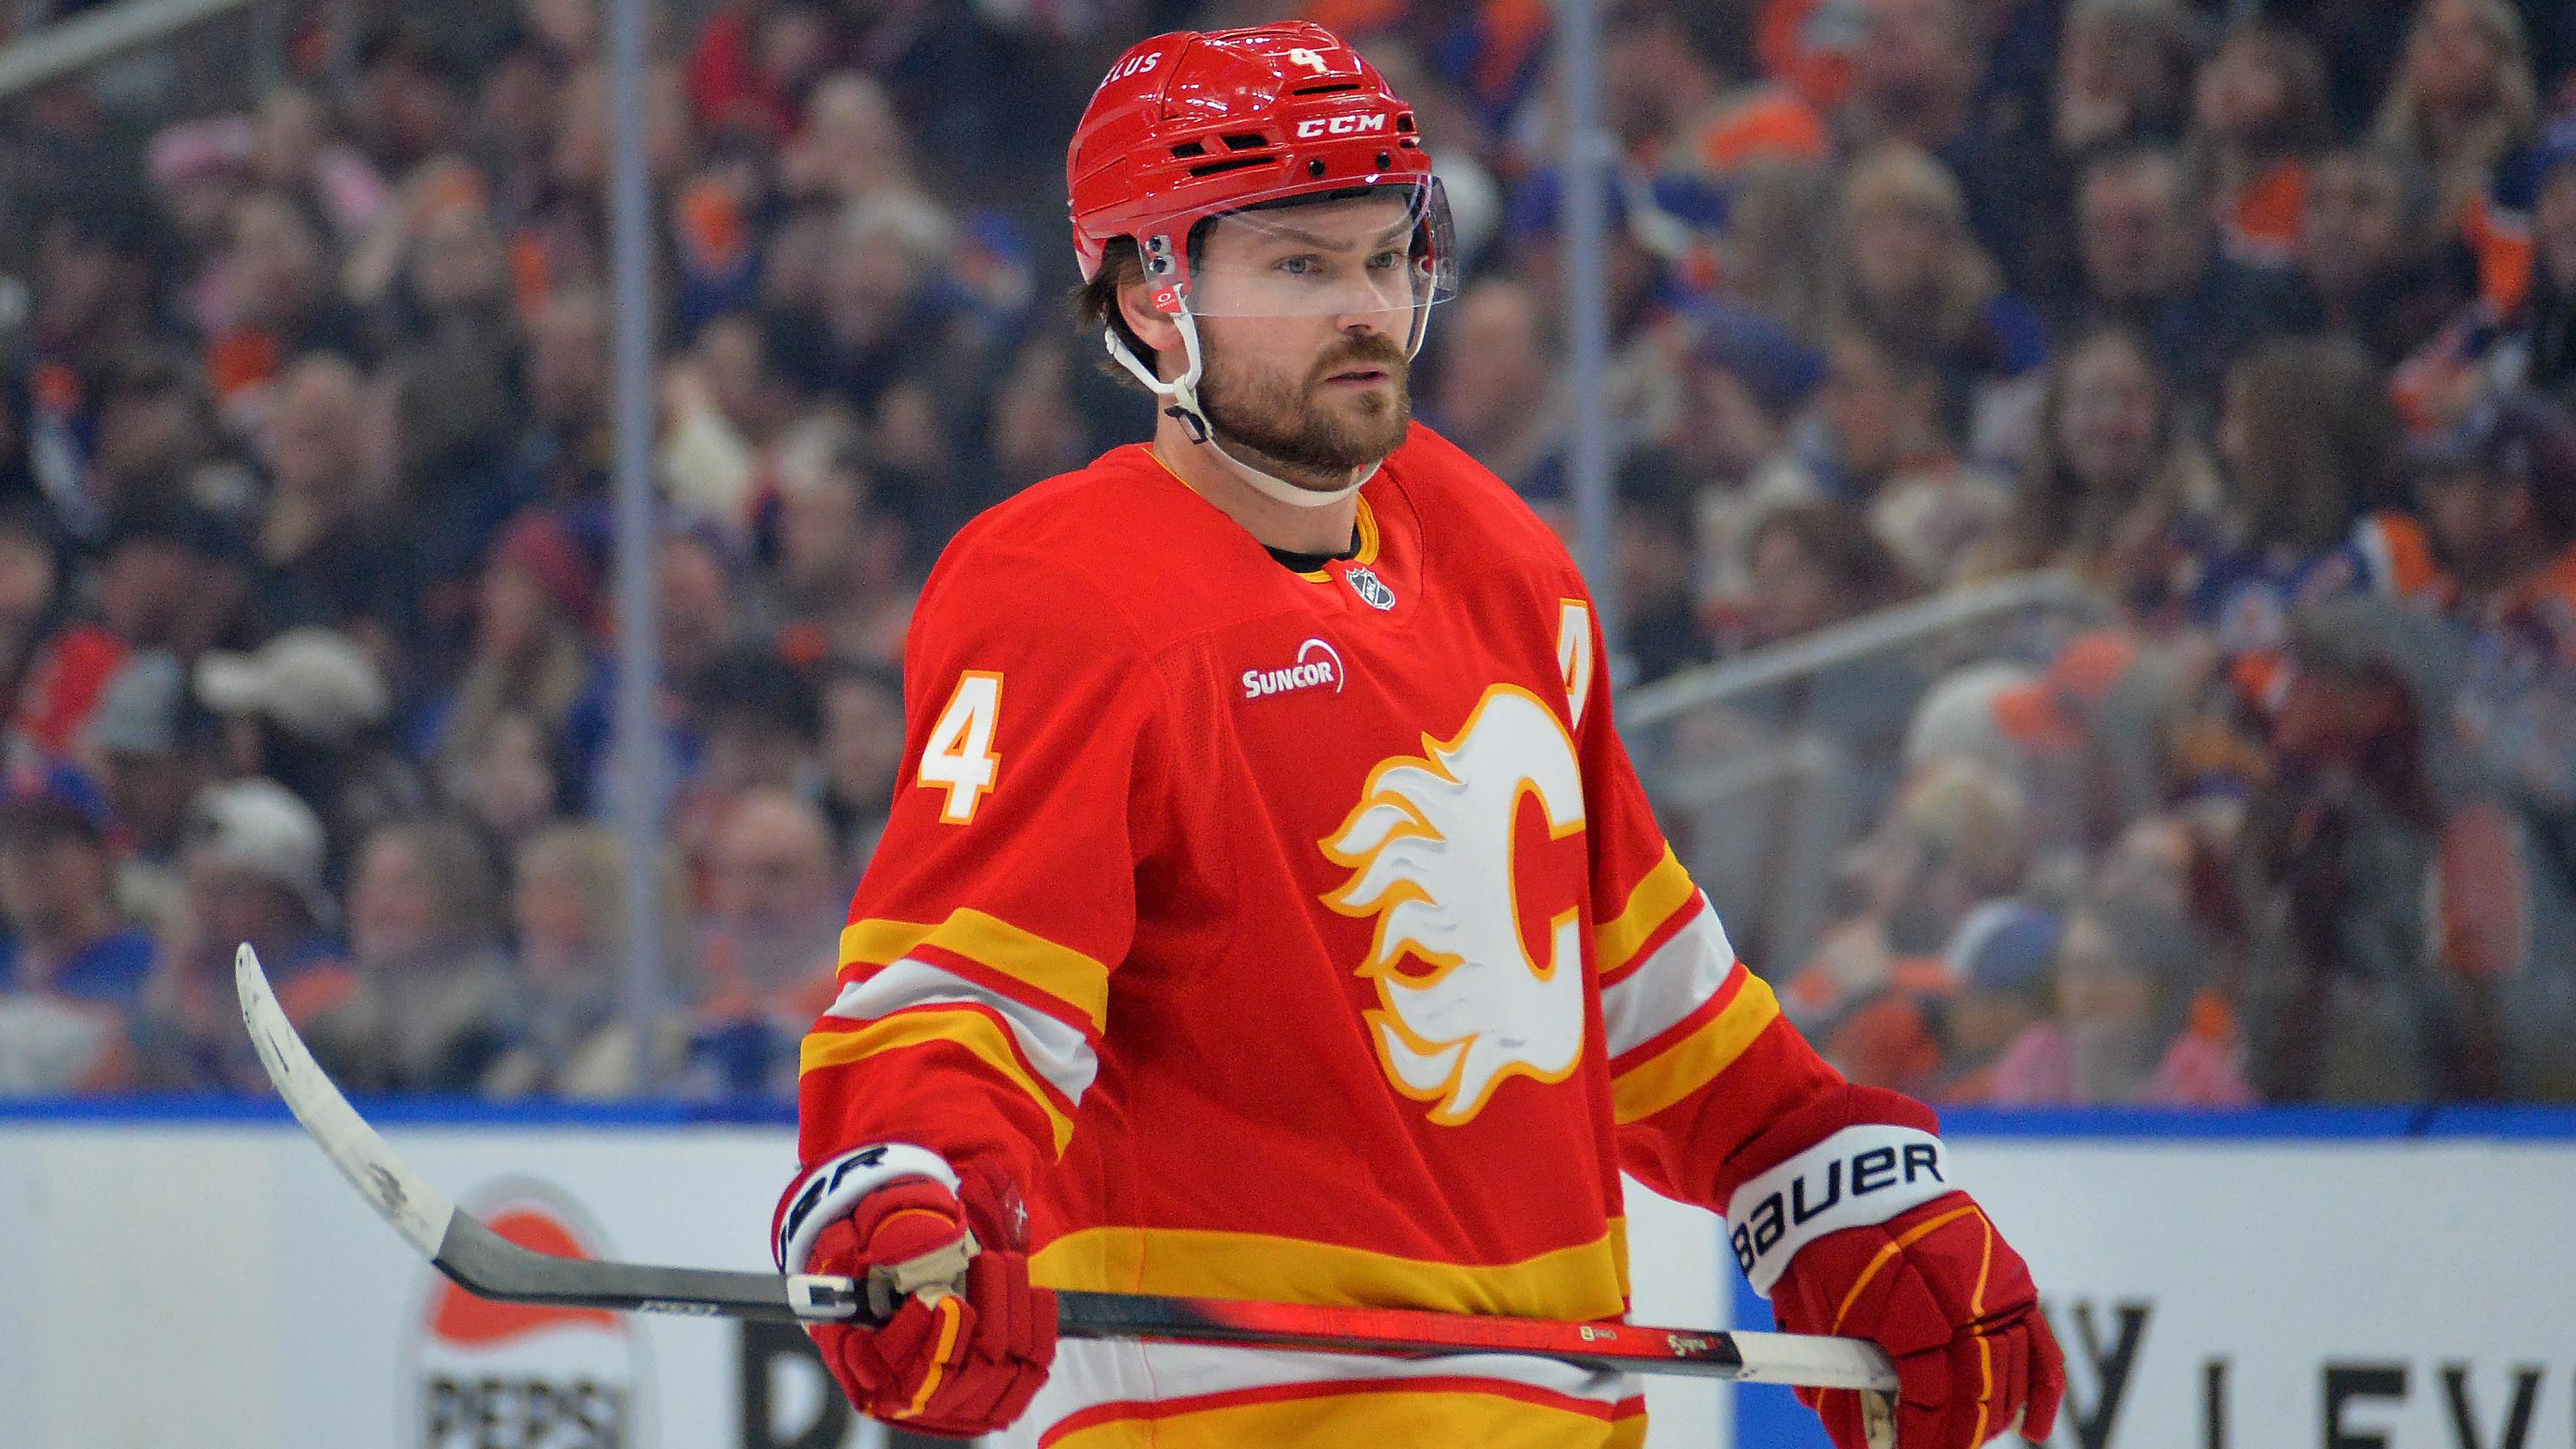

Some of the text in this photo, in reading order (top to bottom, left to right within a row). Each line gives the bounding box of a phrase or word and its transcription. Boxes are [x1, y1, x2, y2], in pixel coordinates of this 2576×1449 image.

[1099, 52, 1163, 89] ELUS
[1290, 48, 1327, 73] 4
[1297, 114, 1386, 138] CCM
[916, 670, 1005, 826] 4
